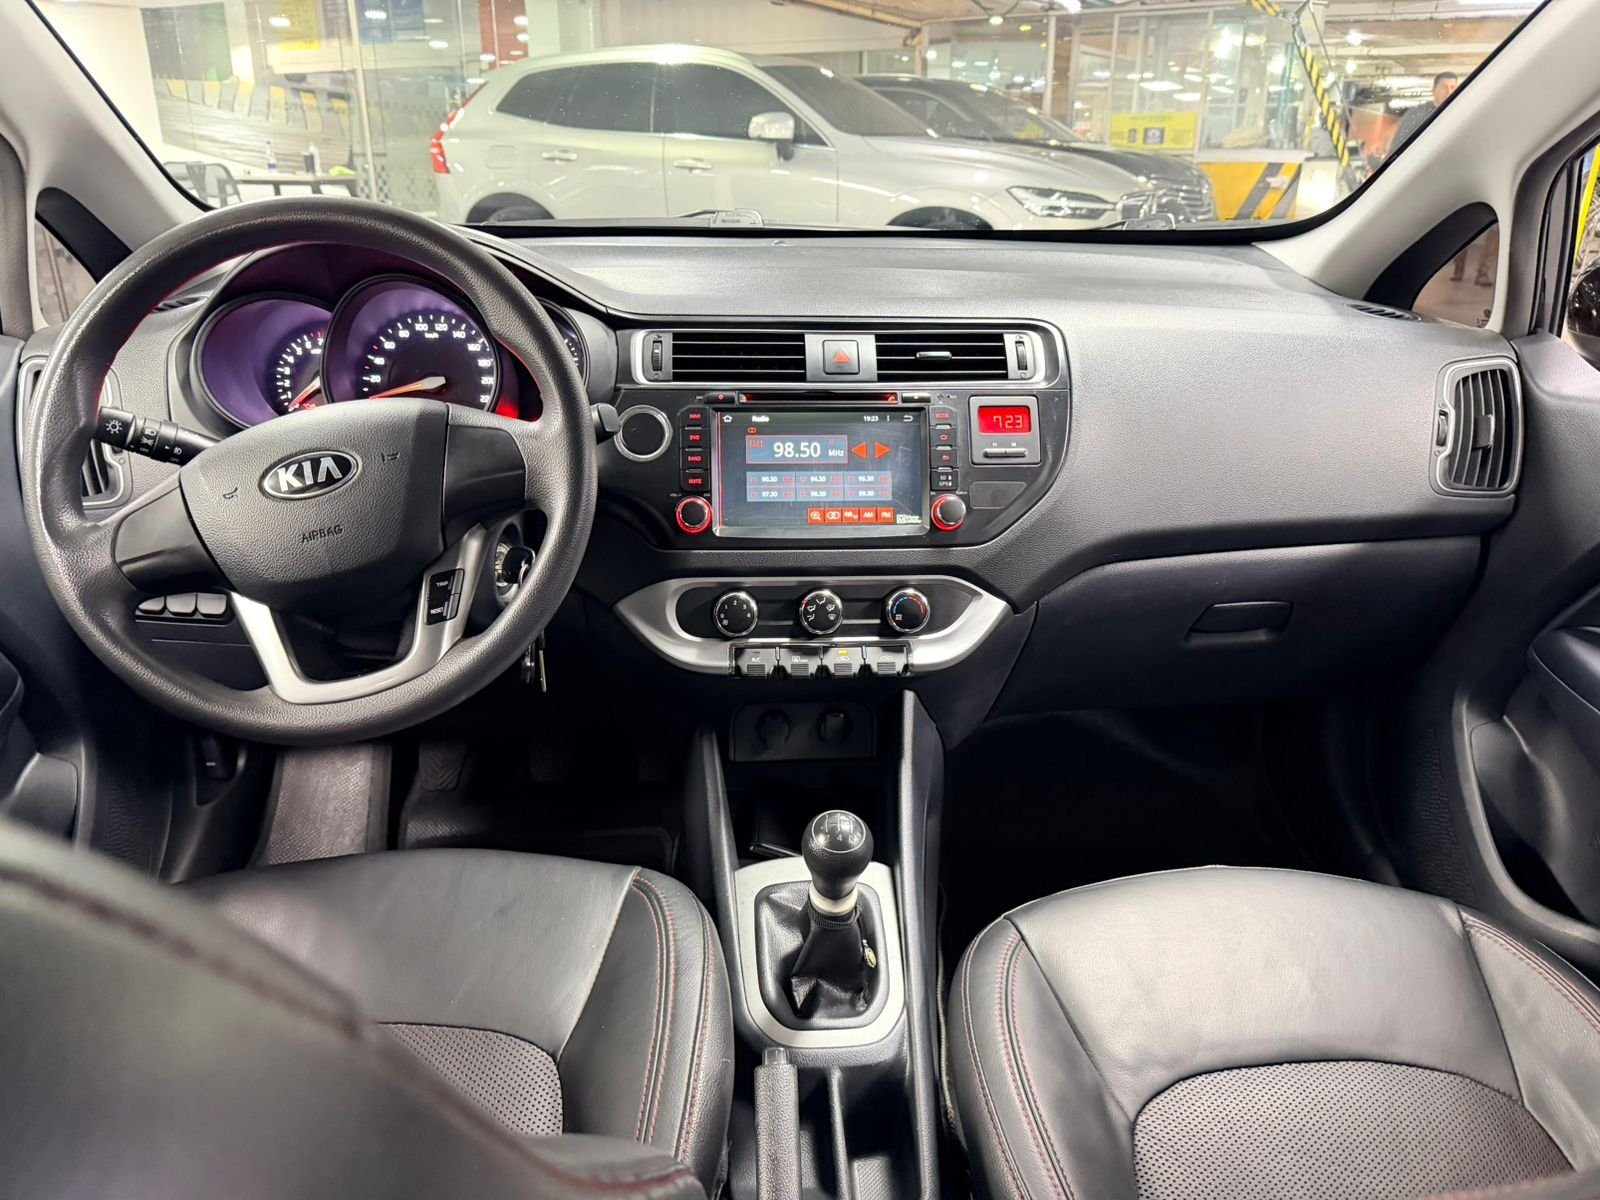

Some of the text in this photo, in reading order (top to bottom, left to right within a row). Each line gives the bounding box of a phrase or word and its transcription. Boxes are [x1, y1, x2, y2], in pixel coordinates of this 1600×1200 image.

[415, 323, 428, 331] 100
[435, 323, 448, 331] 120
[398, 330, 410, 338] 80
[452, 330, 466, 339] 140
[384, 341, 396, 349] 60
[467, 343, 481, 351] 160
[373, 357, 385, 365] 40
[369, 375, 381, 383] 20
[773, 441, 821, 458] 98.50
[828, 449, 845, 457] MHz
[277, 456, 343, 492] KIA
[302, 524, 344, 543] AIRBAG
